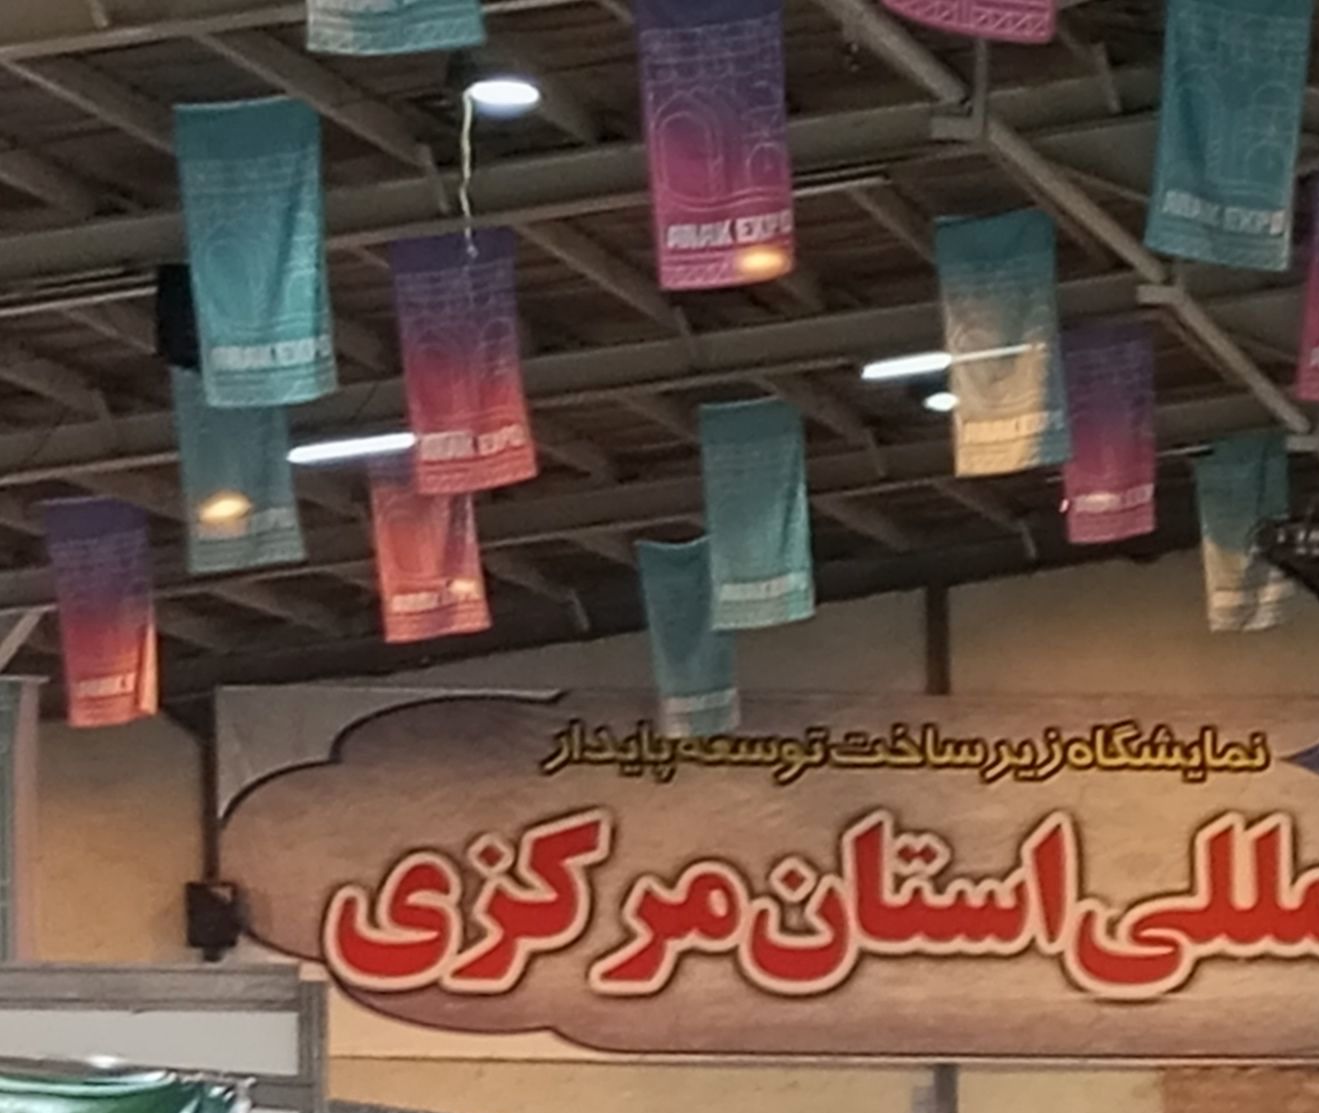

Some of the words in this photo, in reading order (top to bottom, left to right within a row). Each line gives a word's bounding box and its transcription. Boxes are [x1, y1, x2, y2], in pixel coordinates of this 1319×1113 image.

[539, 719, 677, 784] پایدار
[676, 726, 830, 786] توسعه
[1066, 720, 1271, 784] نمایشگاه
[324, 805, 748, 994] مرکزی
[742, 808, 1076, 994] استان
